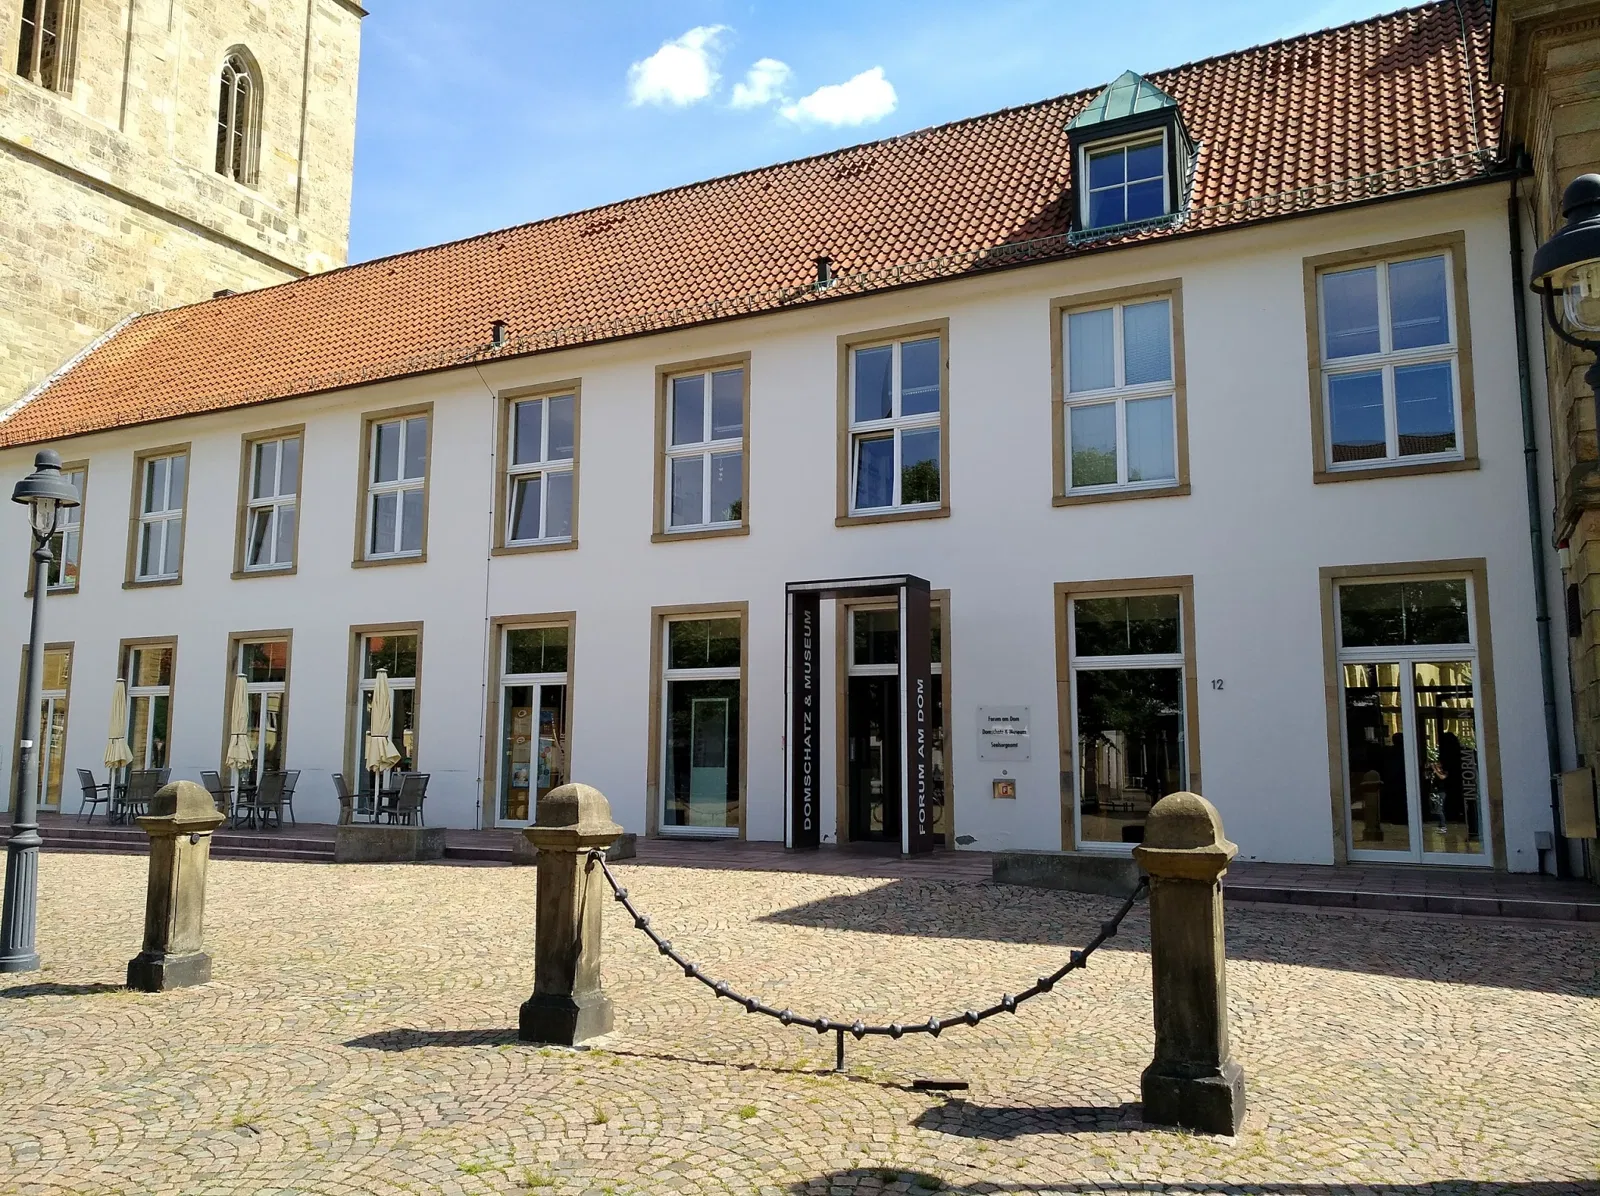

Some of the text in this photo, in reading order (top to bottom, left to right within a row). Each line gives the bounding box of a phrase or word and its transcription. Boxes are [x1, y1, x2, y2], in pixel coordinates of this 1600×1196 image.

[803, 610, 812, 831] DOMSCHATZ & MUSEUM
[1211, 678, 1224, 690] 12
[916, 678, 926, 835] FORUM AM DOM
[1458, 708, 1476, 801] INFORMN
